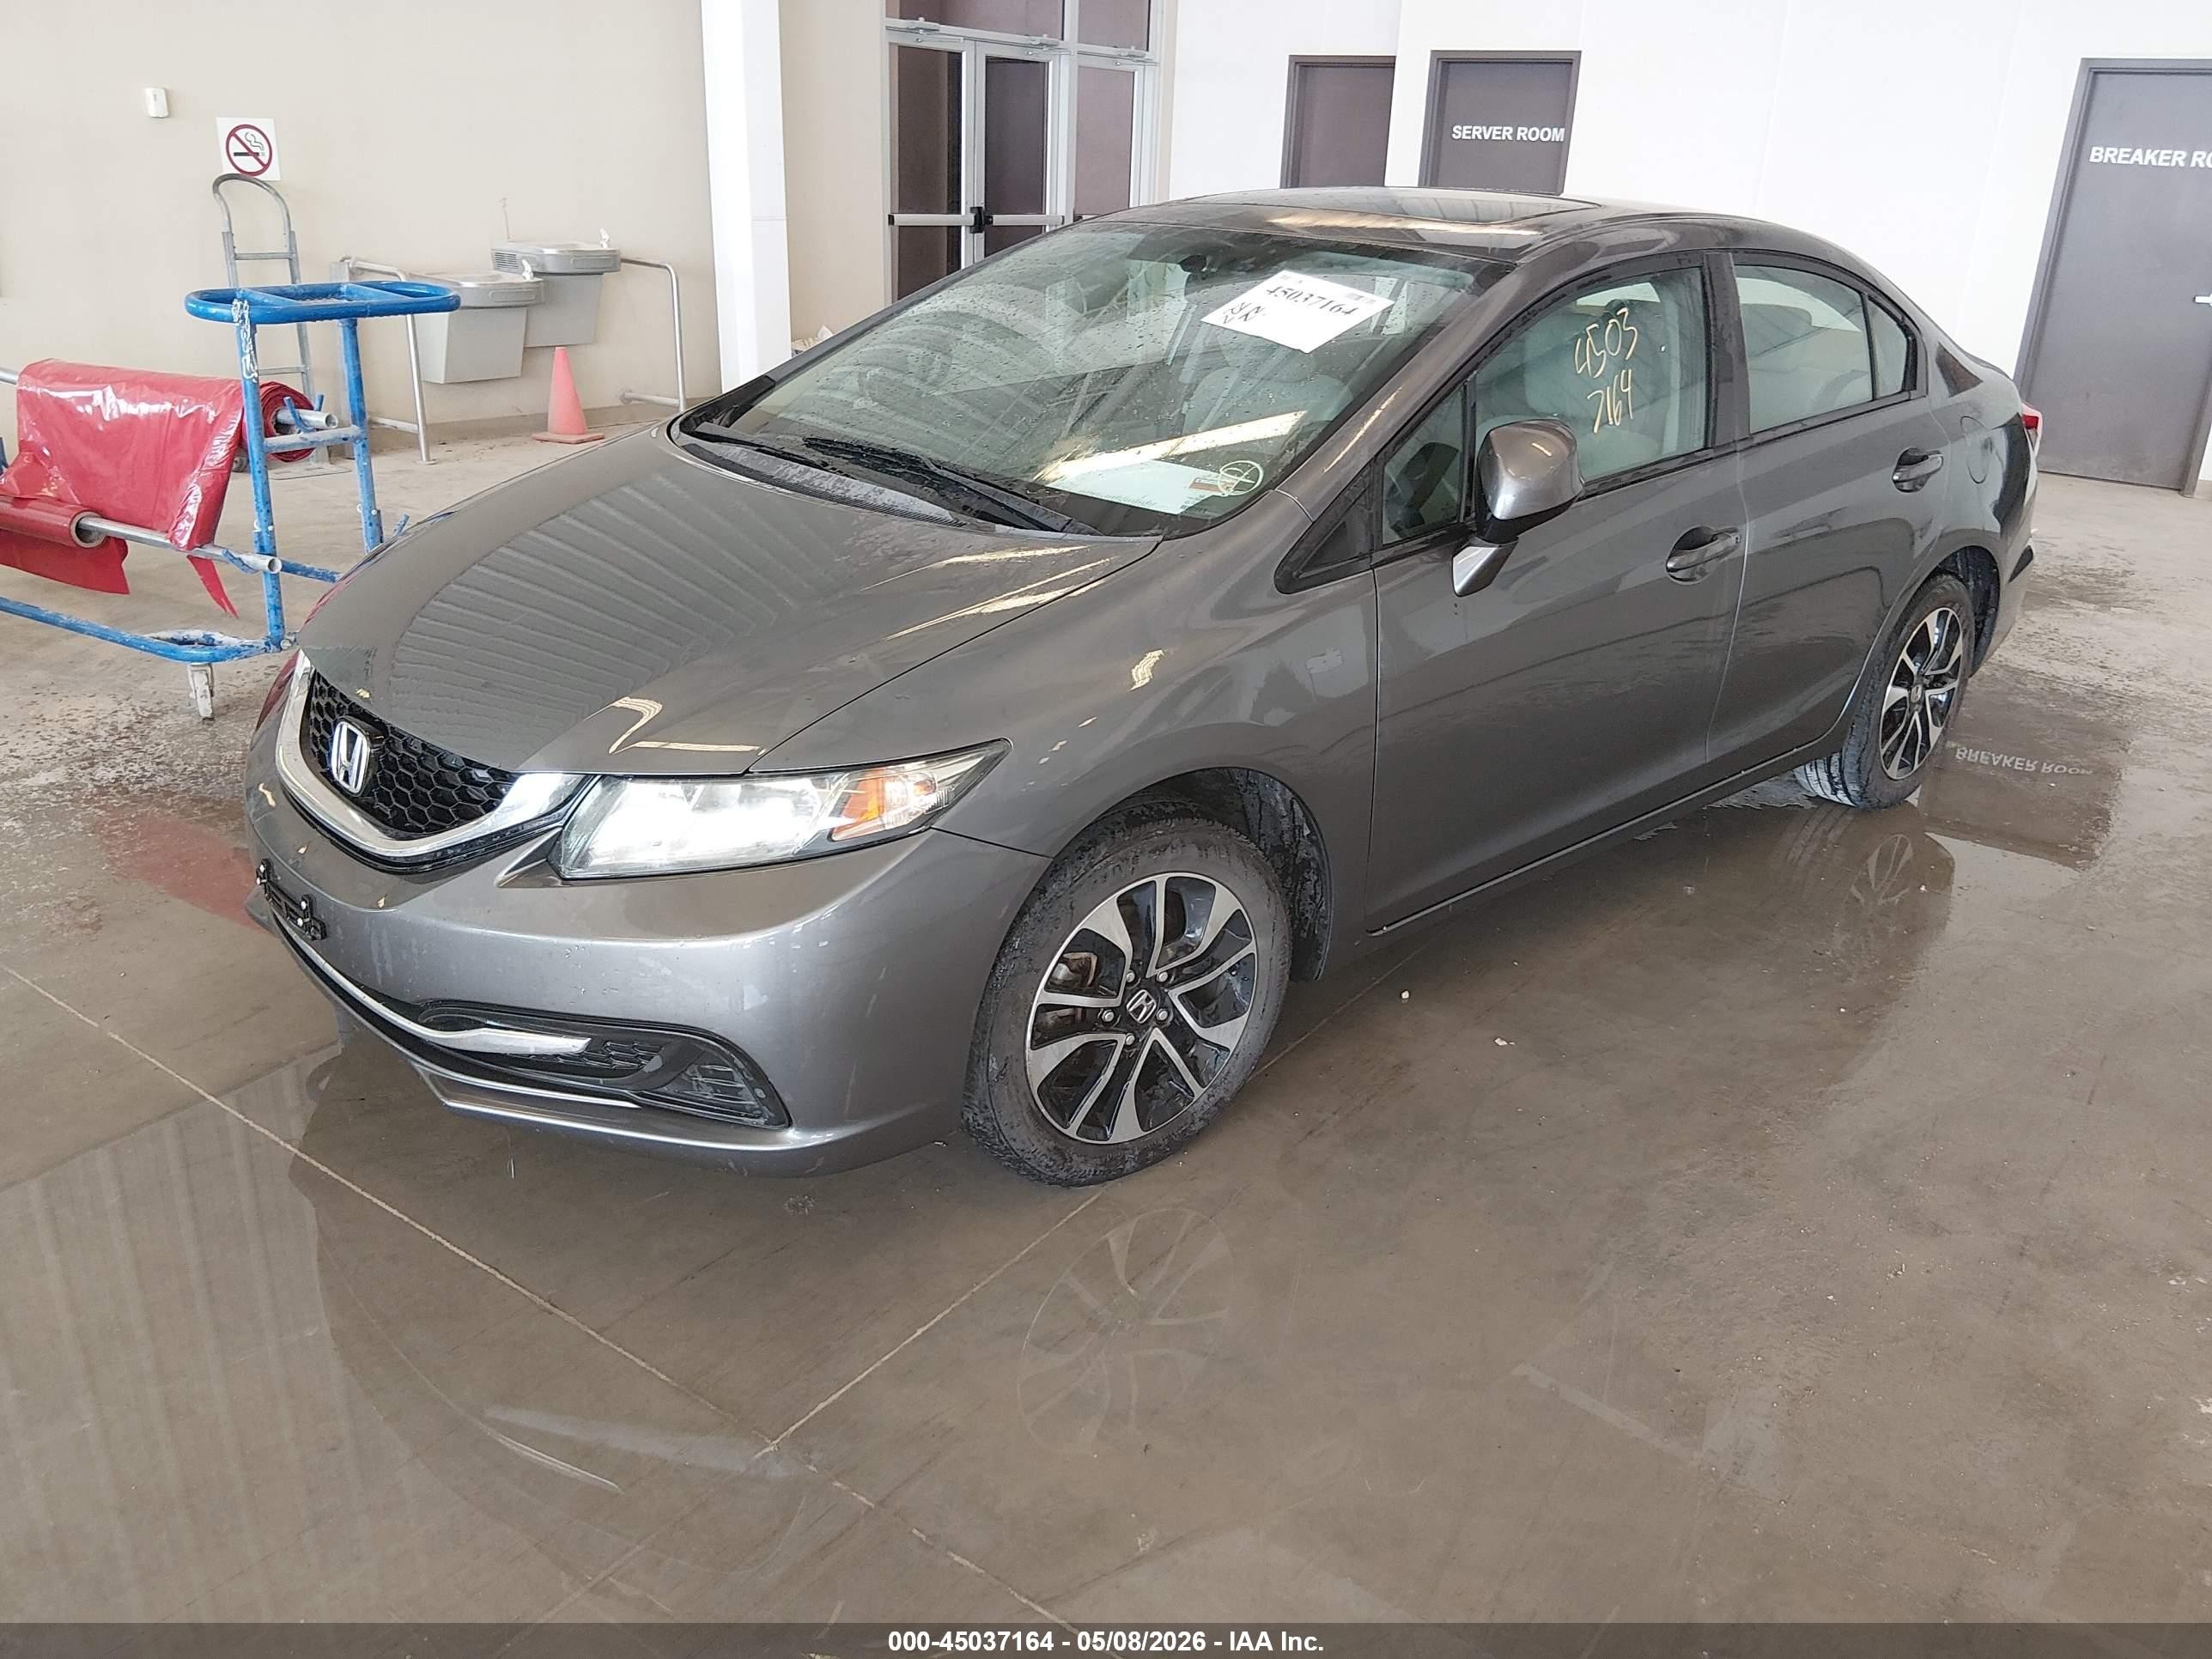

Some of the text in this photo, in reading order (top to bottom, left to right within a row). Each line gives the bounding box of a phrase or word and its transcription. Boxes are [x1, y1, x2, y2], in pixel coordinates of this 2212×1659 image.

[1451, 125, 1565, 143] SERVER ROOM
[2088, 146, 2186, 167] BREAKER
[1265, 284, 1359, 317] 45037164
[1574, 307, 1638, 379] 4503
[1586, 368, 1633, 434] 7164
